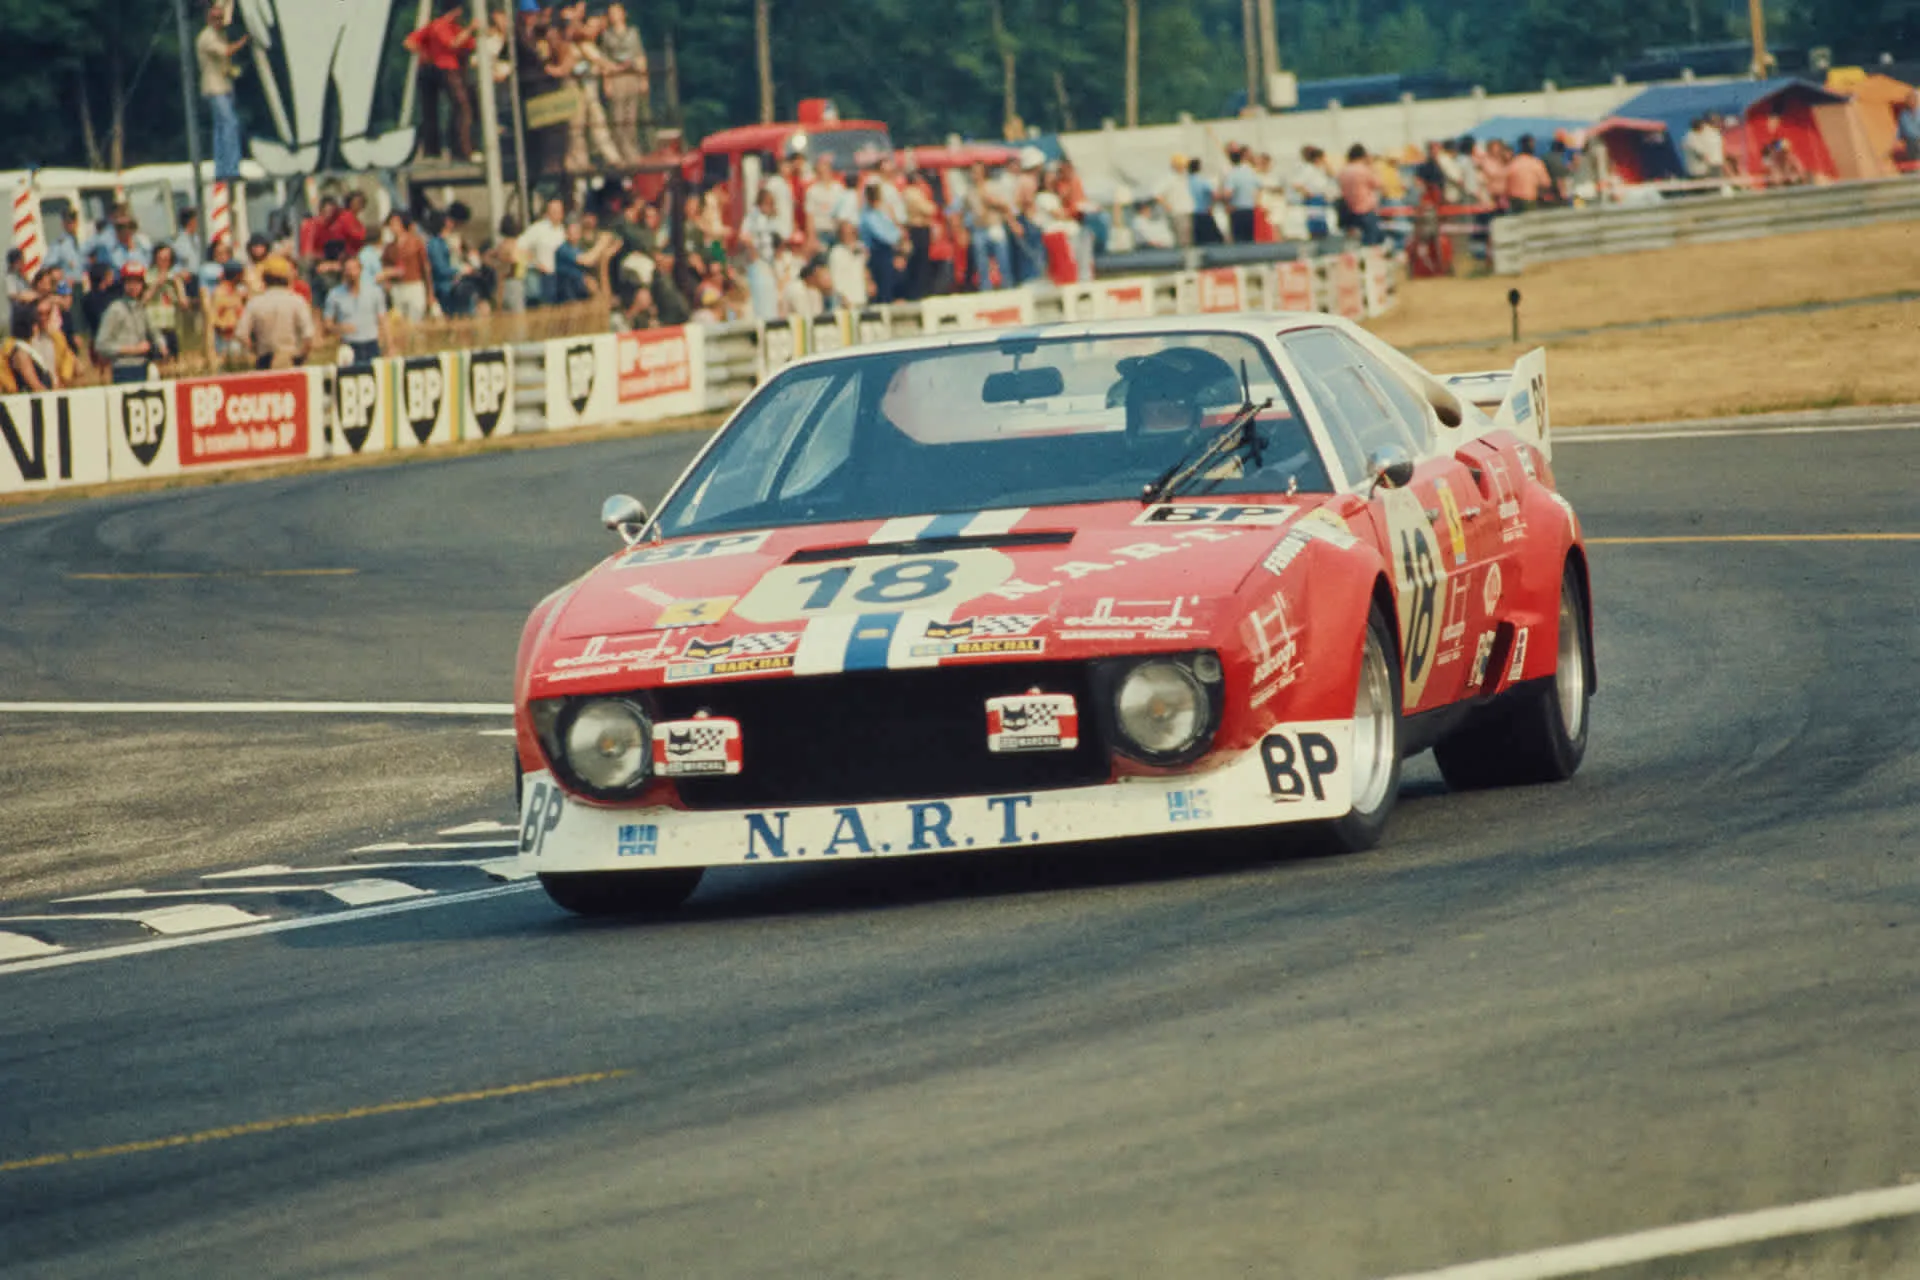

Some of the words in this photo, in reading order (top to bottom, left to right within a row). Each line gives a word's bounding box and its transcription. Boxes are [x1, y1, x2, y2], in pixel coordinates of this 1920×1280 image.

[190, 384, 224, 428] BP
[340, 375, 375, 428] BP
[407, 368, 441, 421] BP
[472, 361, 505, 414] BP
[127, 398, 164, 444] BP
[1146, 506, 1284, 523] BP
[624, 535, 760, 567] BP
[797, 559, 960, 610] 18
[1400, 527, 1437, 683] 18
[714, 656, 790, 673] MARCHAL
[956, 639, 1035, 654] MARCHAL
[1260, 732, 1338, 803] BP
[520, 782, 563, 857] BP
[744, 795, 1041, 860] N.A.R.T.
